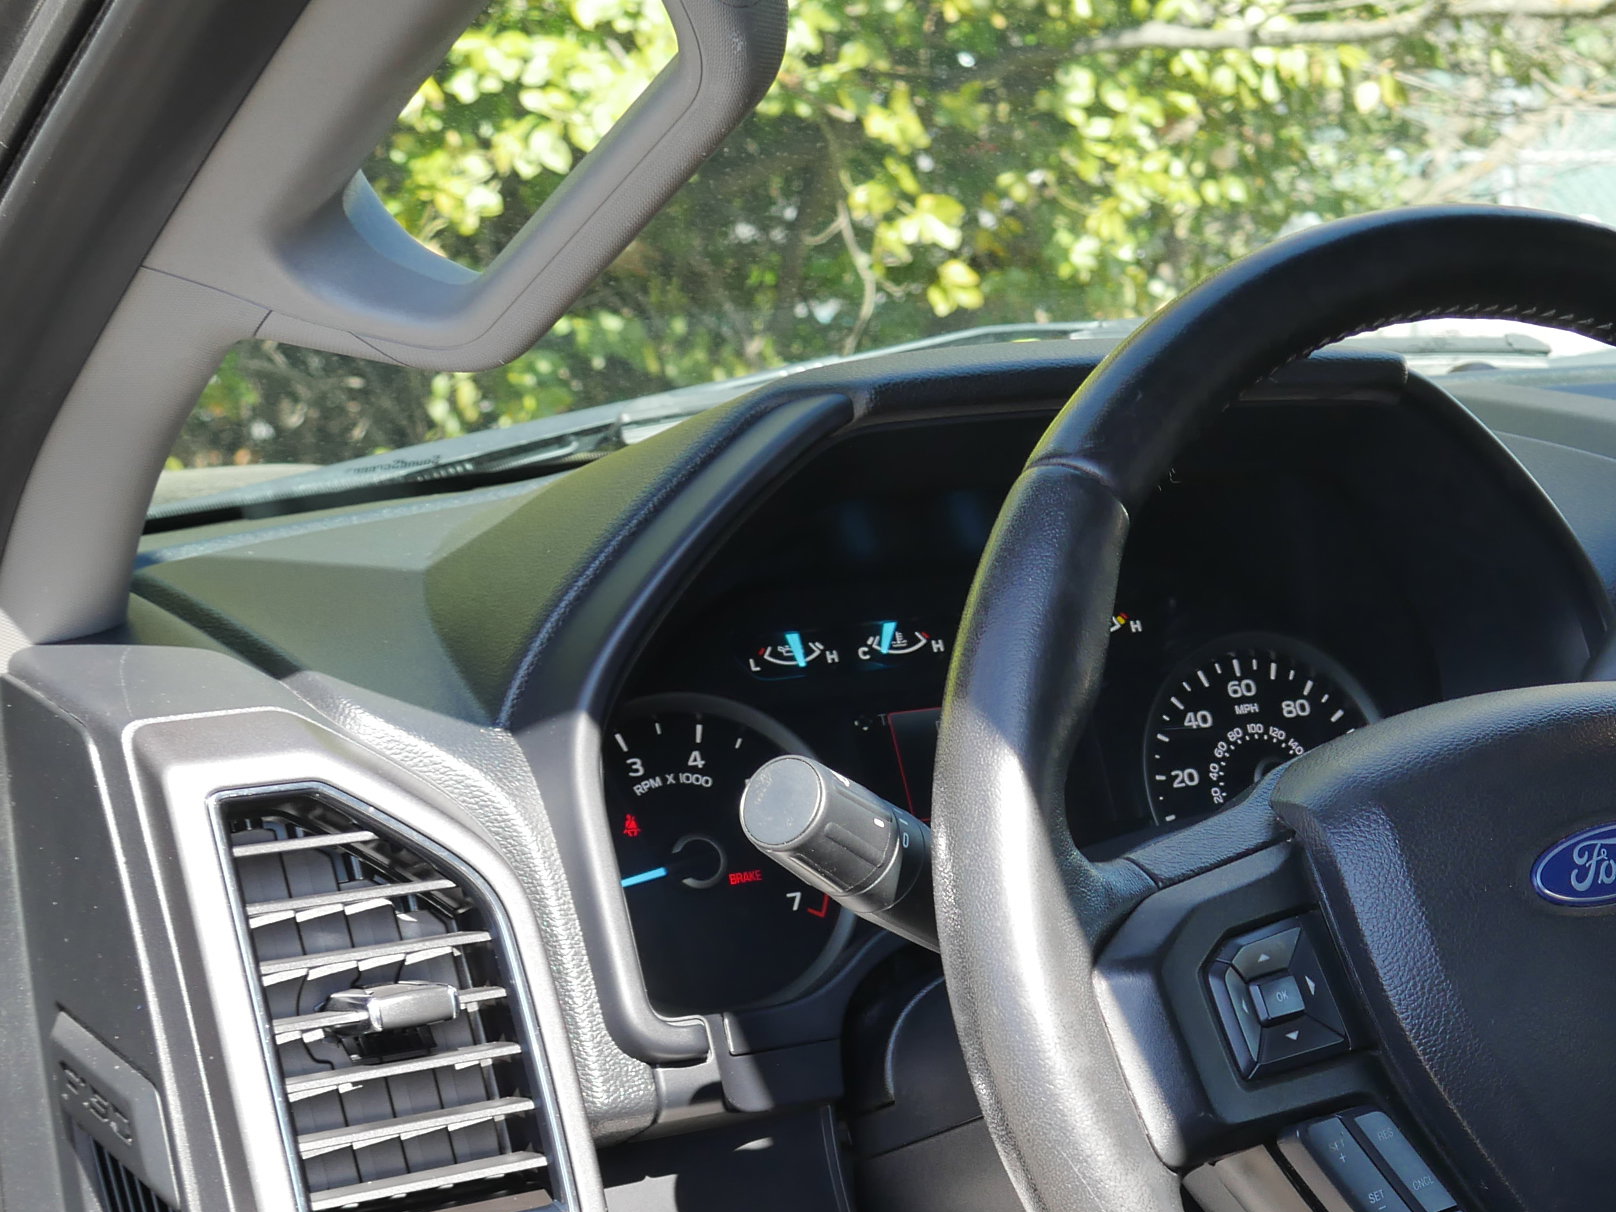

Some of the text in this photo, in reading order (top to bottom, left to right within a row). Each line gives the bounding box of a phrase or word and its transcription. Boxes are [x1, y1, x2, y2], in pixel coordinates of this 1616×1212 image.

[1227, 679, 1257, 698] 60
[1234, 703, 1259, 715] MPH
[1281, 699, 1311, 718] 80
[1183, 710, 1213, 729] 40
[1227, 727, 1243, 742] 80
[1246, 723, 1264, 734] 100
[1268, 725, 1286, 740] 120
[1214, 741, 1227, 757] 60
[1287, 738, 1304, 755] 140
[626, 758, 645, 777] 3
[688, 750, 705, 769] 4
[1170, 769, 1199, 788] 20
[1208, 763, 1219, 781] 40
[633, 773, 713, 796] RPM X 1000
[1211, 787, 1224, 804] 20
[728, 869, 762, 885] BRAKE
[786, 892, 801, 911] 7
[1276, 990, 1289, 1002] OK
[1378, 1129, 1394, 1141] RES
[1413, 1176, 1434, 1190] CNCL
[1368, 1190, 1384, 1204] SET
